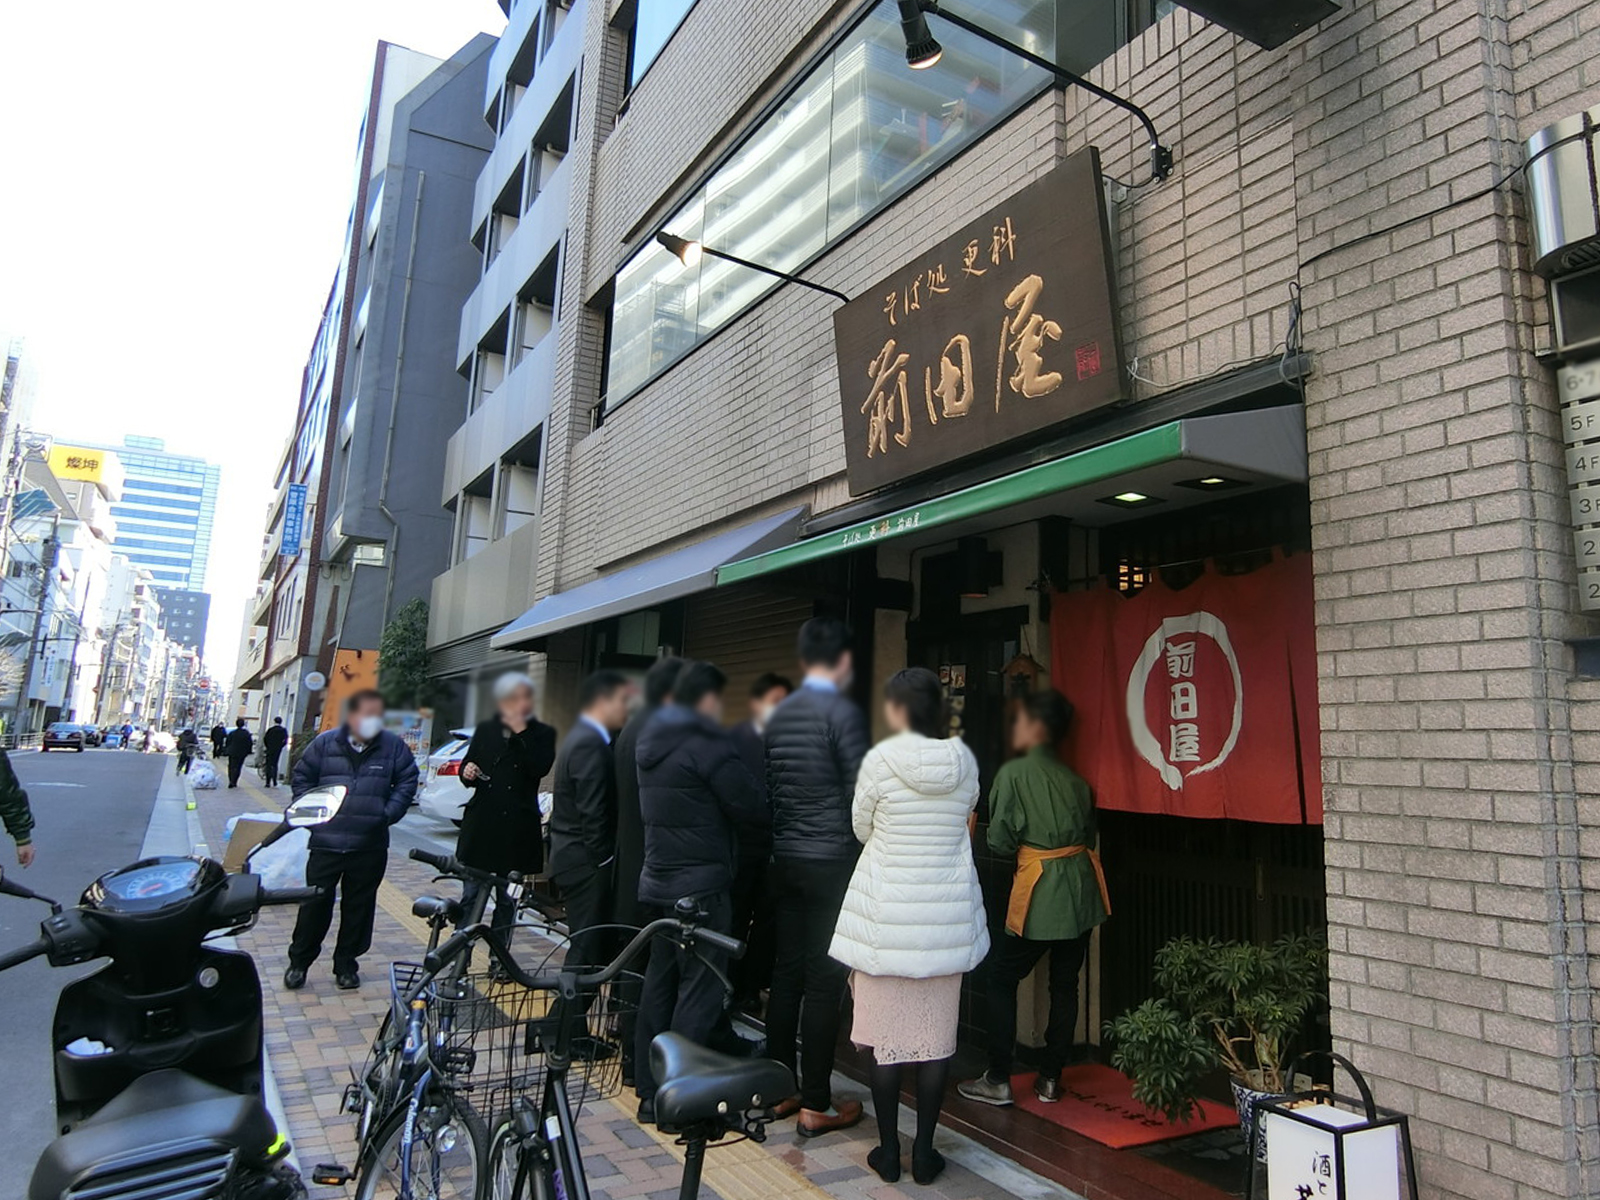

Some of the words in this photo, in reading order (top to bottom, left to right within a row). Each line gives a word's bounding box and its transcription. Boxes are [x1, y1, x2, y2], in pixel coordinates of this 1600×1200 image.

[883, 263, 950, 326] そば処
[961, 216, 1016, 279] 更科
[860, 274, 1063, 459] 前田屋
[402, 1097, 419, 1144] Coleman
